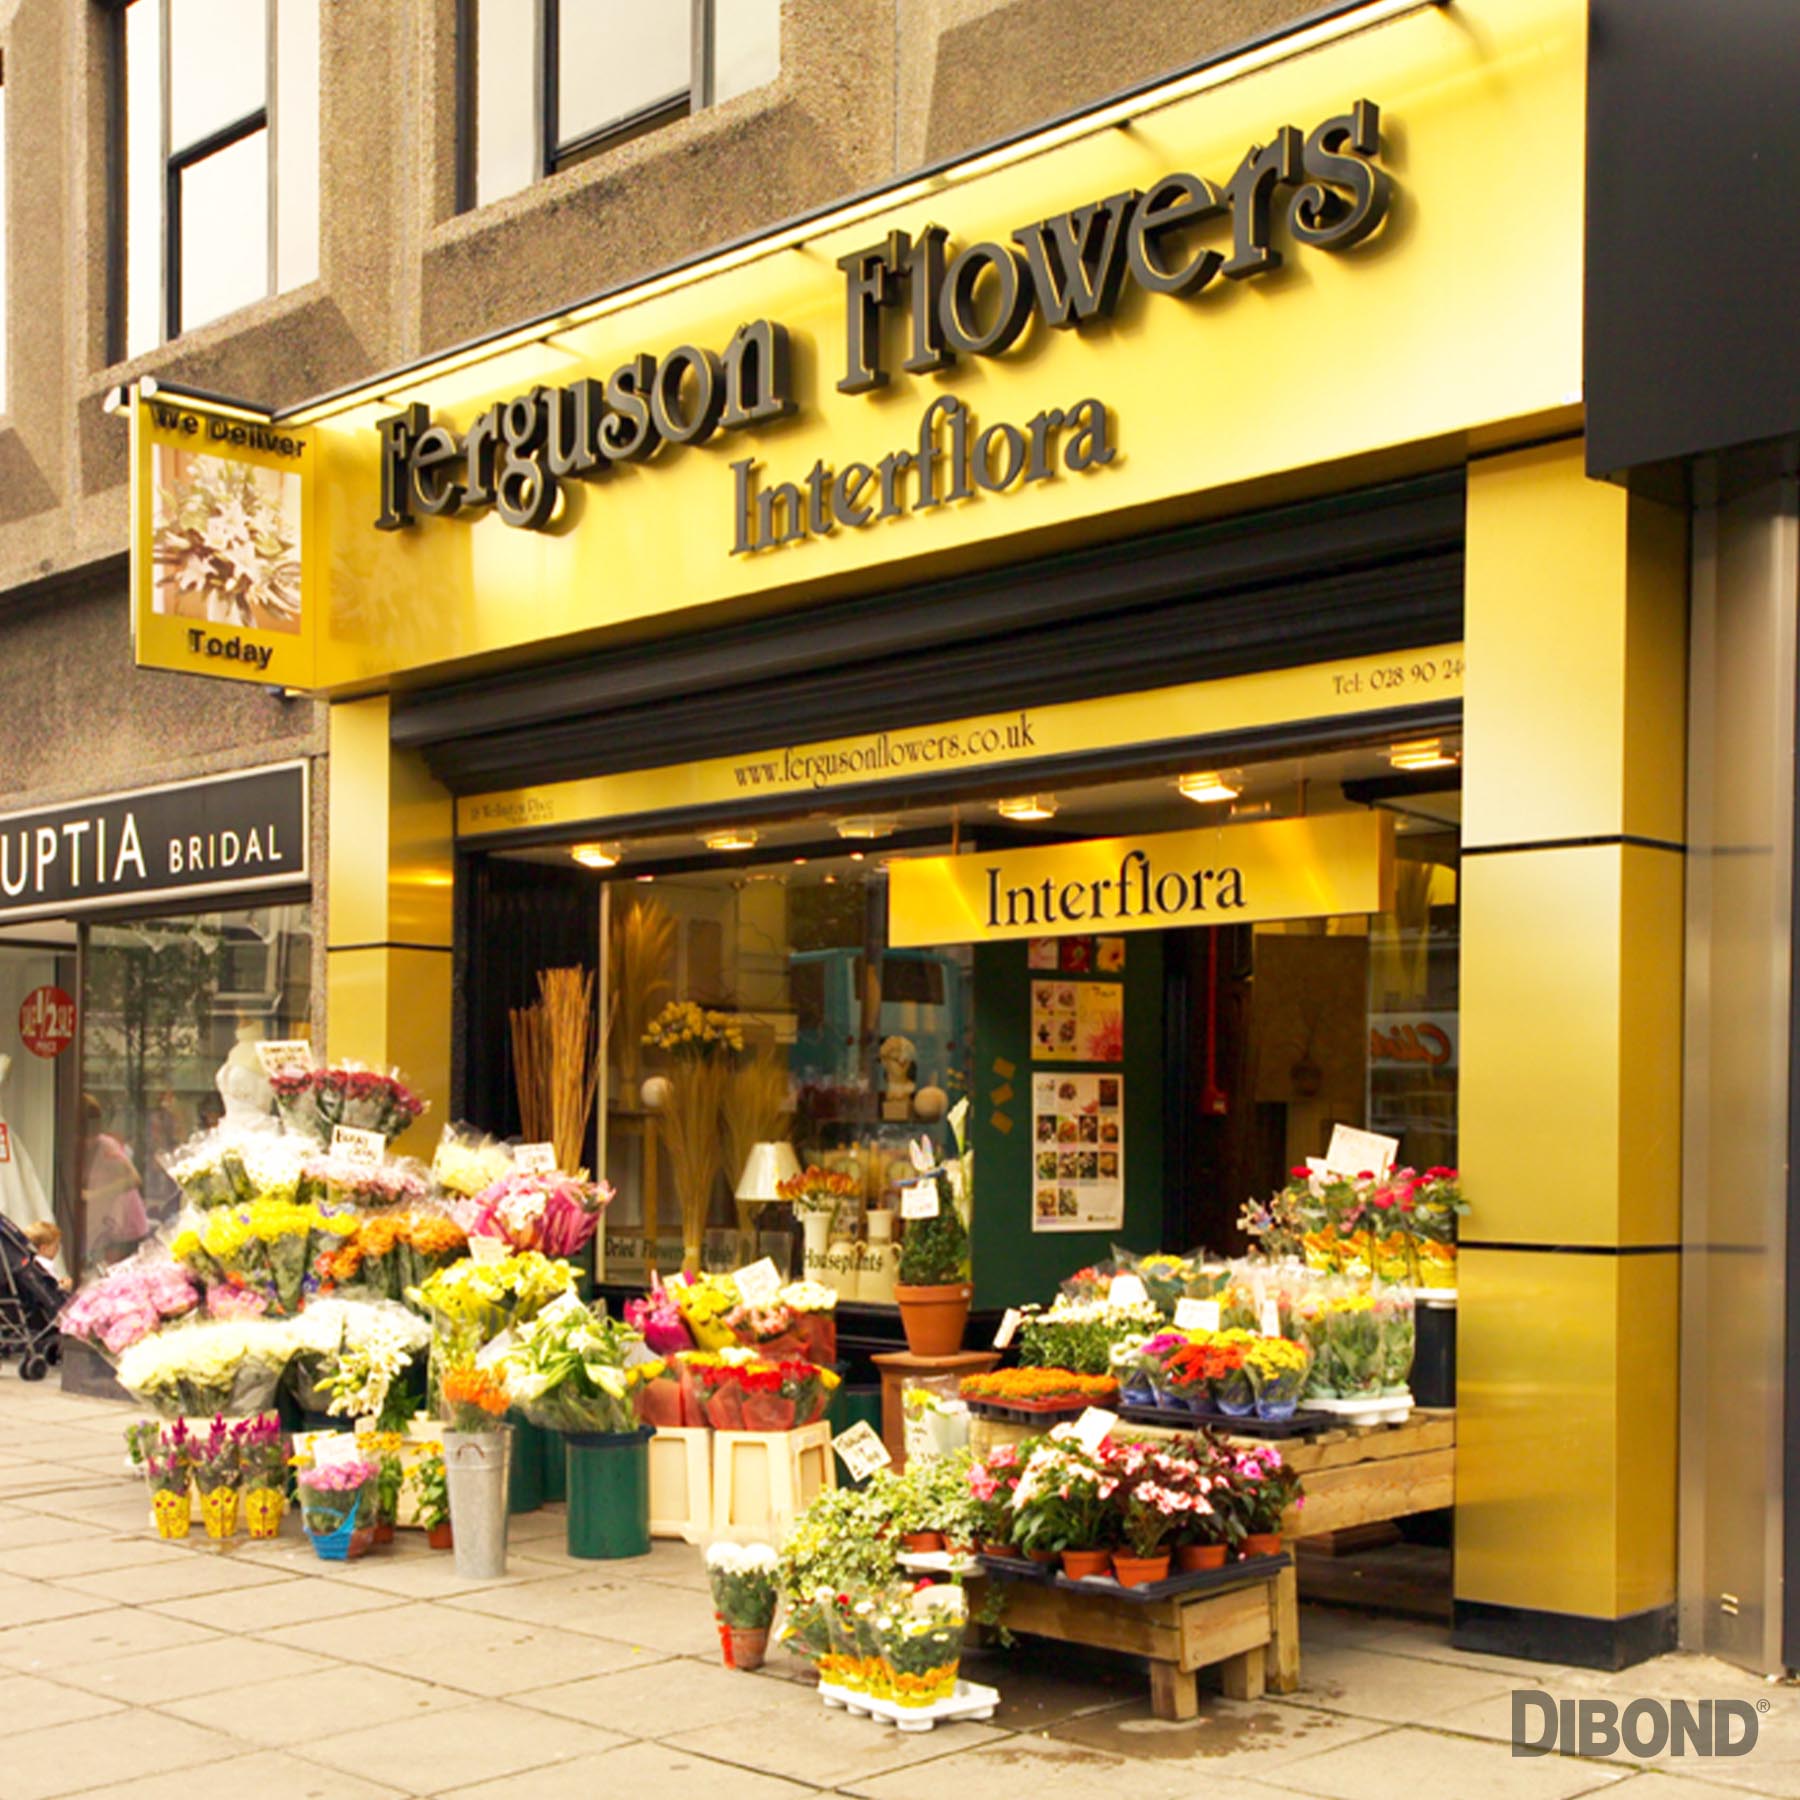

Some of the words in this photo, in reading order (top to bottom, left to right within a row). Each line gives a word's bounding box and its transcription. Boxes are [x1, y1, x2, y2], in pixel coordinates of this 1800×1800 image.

[374, 318, 798, 531] Ferguson
[837, 98, 1392, 395] Flowers
[152, 405, 199, 435] We
[209, 415, 306, 458] Deliver
[729, 394, 1117, 557] Interflora
[188, 628, 274, 669] Today
[1370, 667, 1404, 690] 028
[1411, 660, 1436, 683] 90
[734, 713, 1036, 789] www.fergusonflowers.co.uk
[0, 812, 148, 897] UPTIA
[168, 825, 283, 875] BRIDAL
[985, 850, 1248, 928] Interflora
